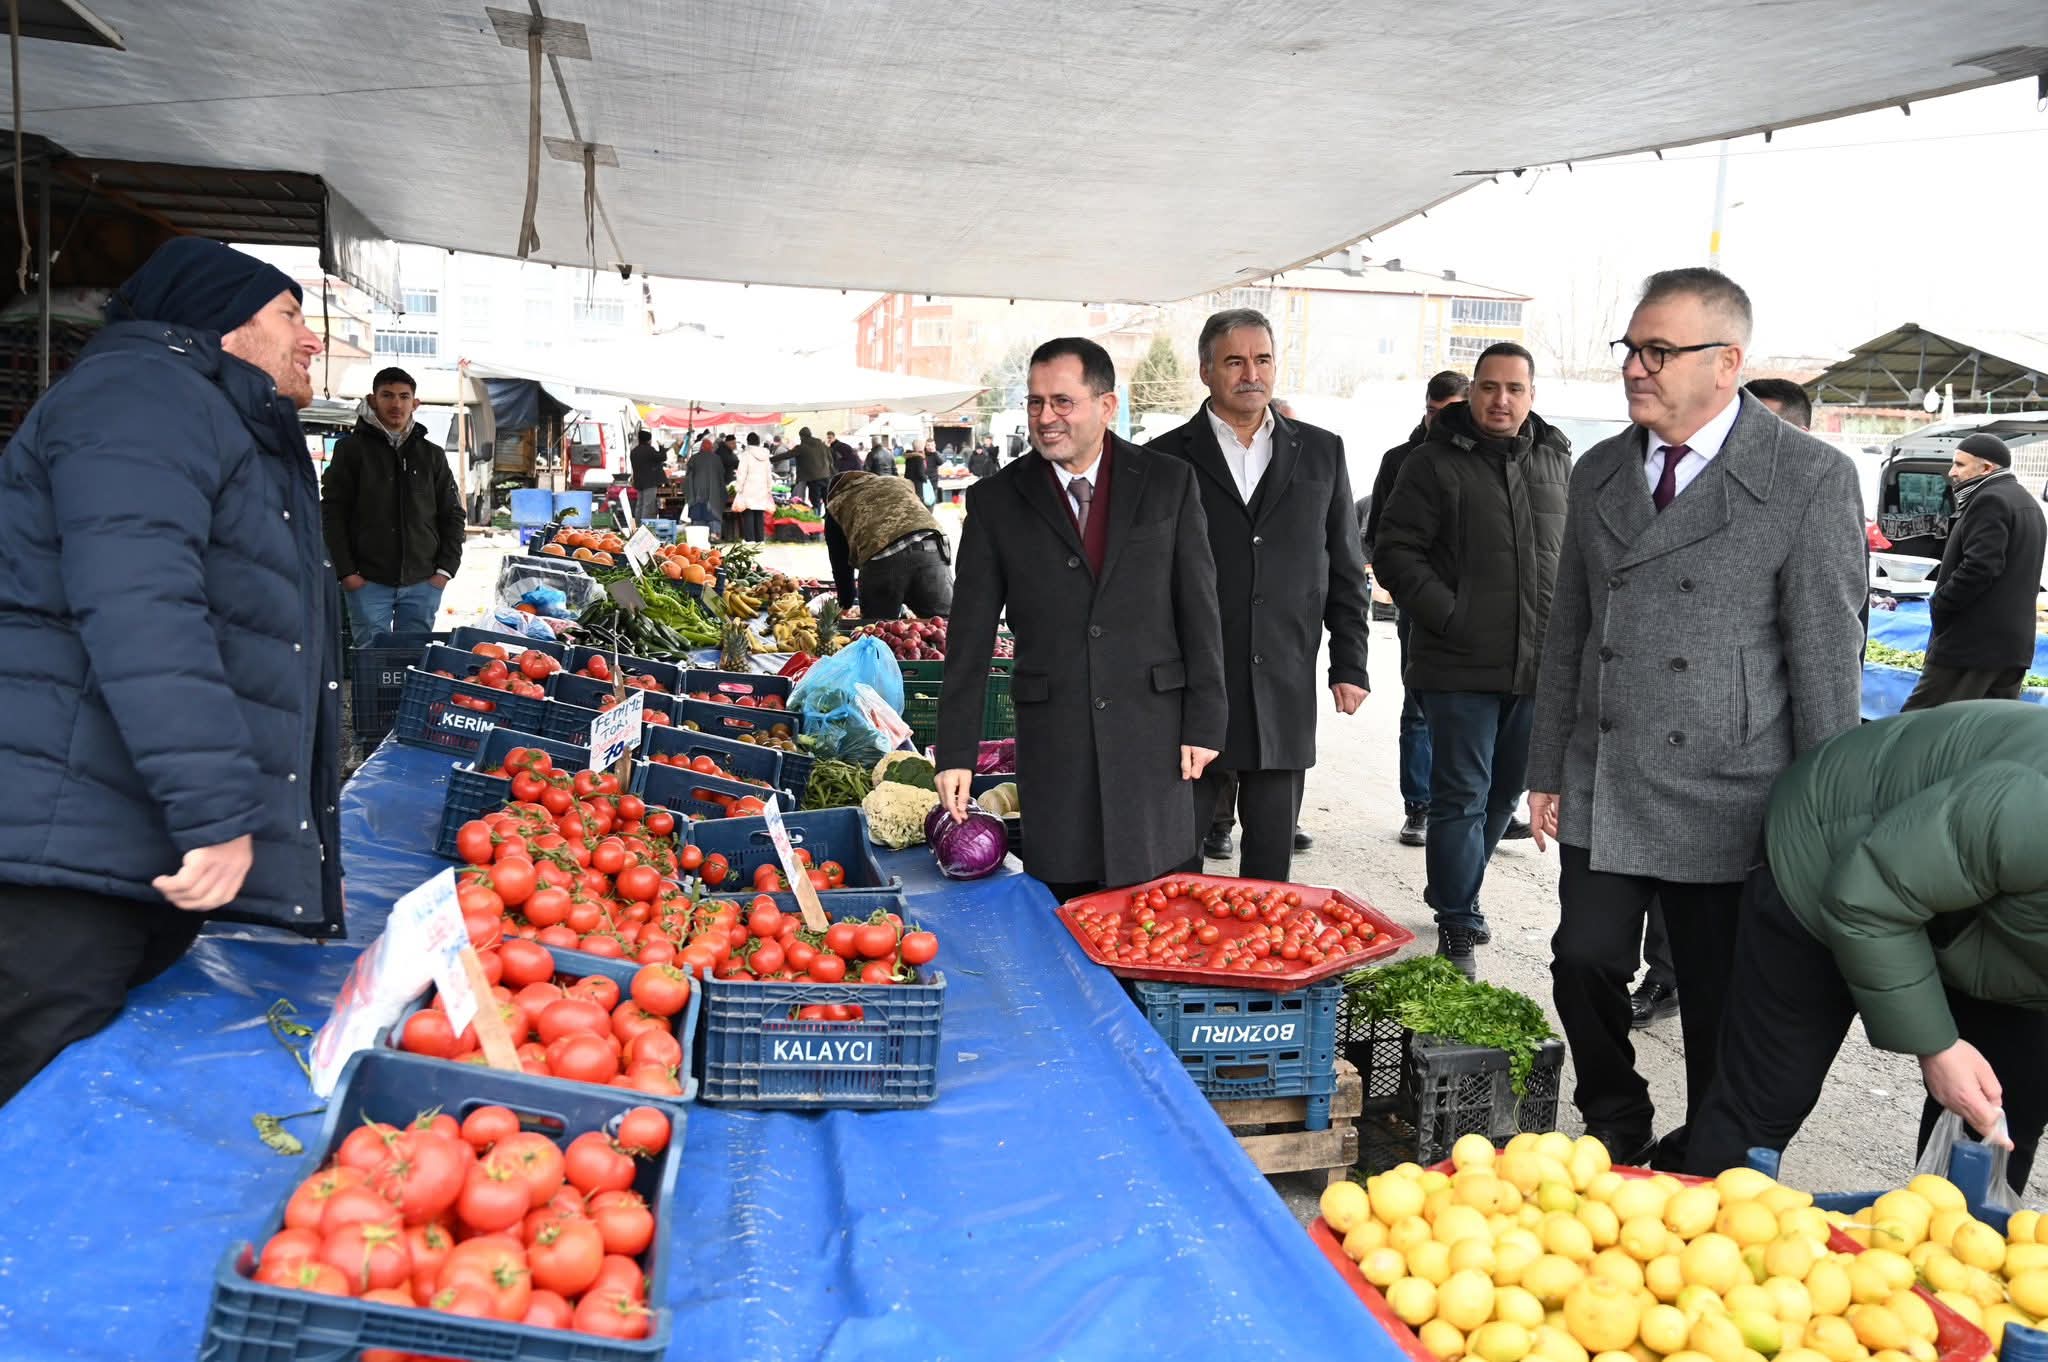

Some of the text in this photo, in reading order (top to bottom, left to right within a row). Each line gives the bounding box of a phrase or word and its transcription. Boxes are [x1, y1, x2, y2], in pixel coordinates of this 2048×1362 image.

[382, 672, 407, 684] BE
[1191, 1023, 1296, 1043] BOZKIRLI
[773, 1040, 873, 1062] KALAYCI
